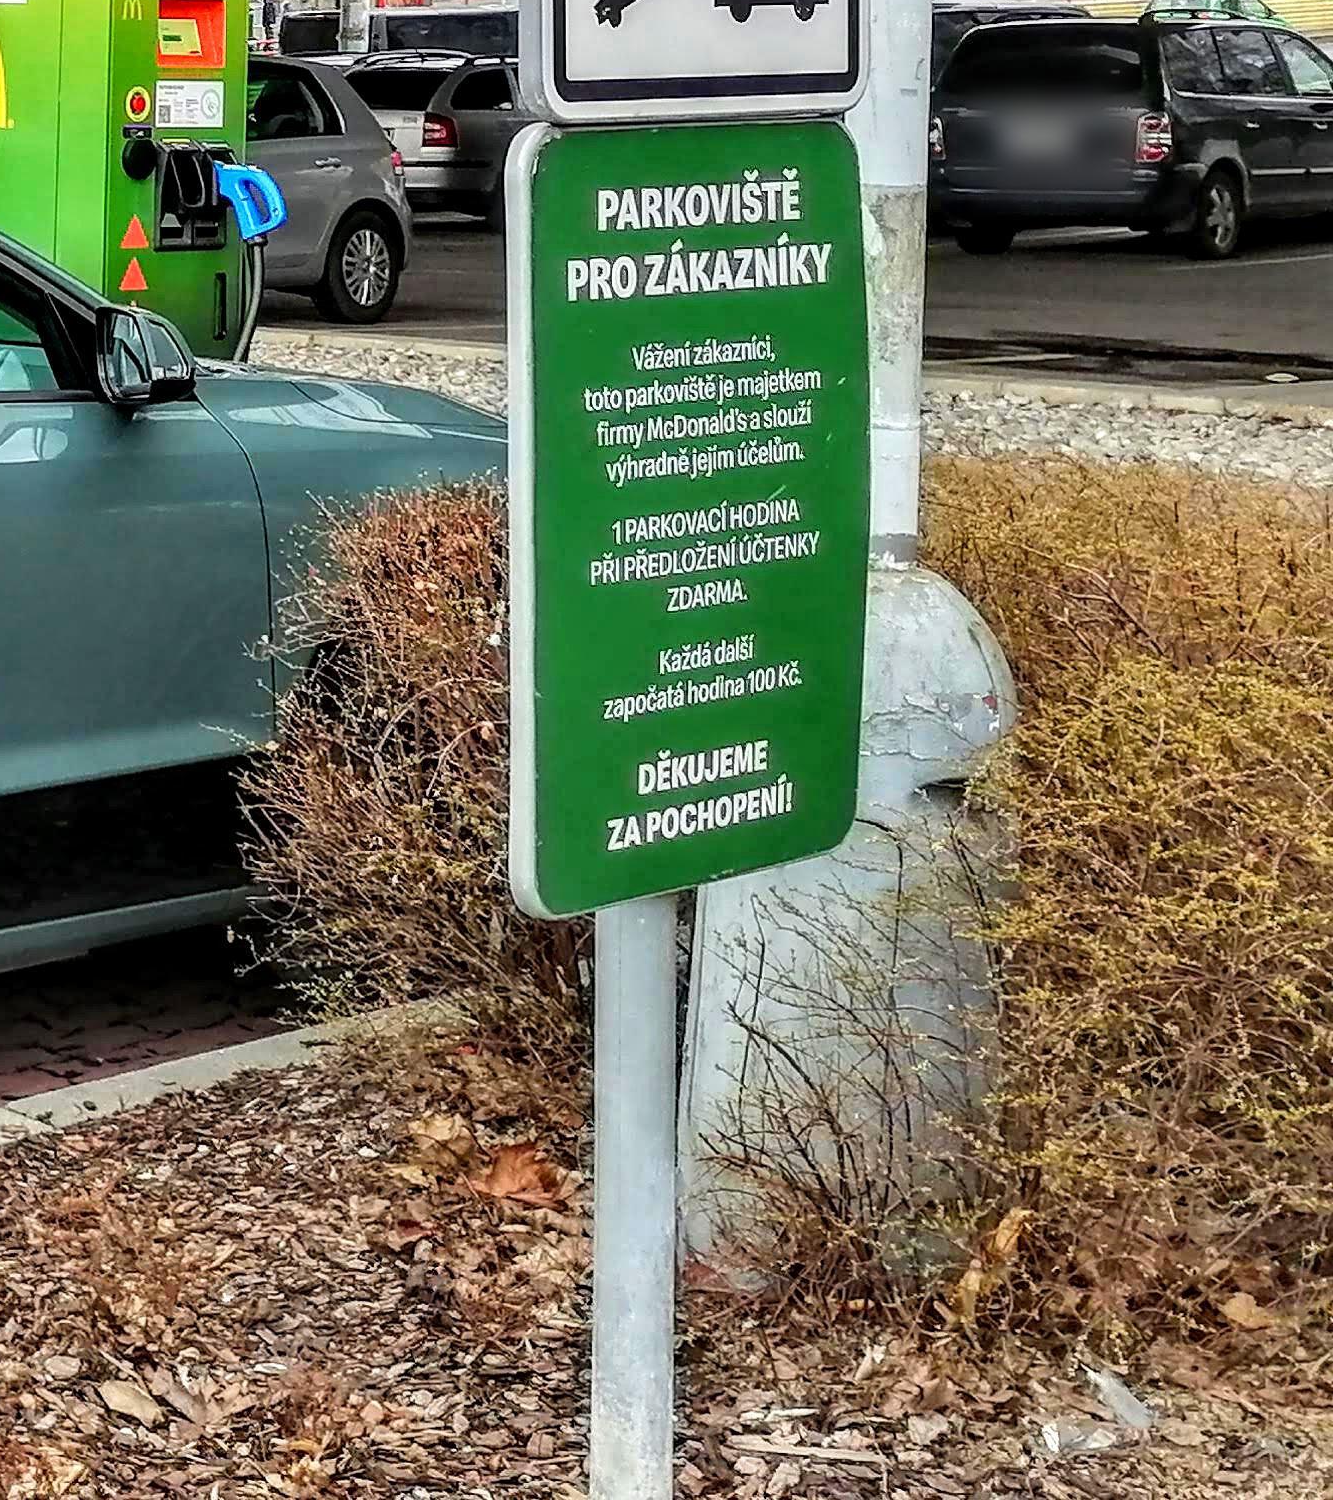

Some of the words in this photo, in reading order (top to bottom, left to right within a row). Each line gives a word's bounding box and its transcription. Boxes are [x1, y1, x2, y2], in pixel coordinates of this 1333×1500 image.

[597, 167, 802, 231] PARKOVIŠTĚ
[567, 256, 637, 301] PRO
[644, 232, 832, 296] ZÁKAZNÍKY
[632, 338, 691, 371] Vážení
[693, 334, 776, 367] zákazníci,
[584, 385, 623, 412] toto
[625, 373, 716, 413] parkoviště
[717, 376, 735, 403] je
[738, 368, 821, 398] majetkem
[596, 419, 646, 448] firmy
[750, 412, 761, 428] a
[763, 399, 813, 426] slouží
[605, 447, 690, 488] výhradně
[690, 444, 735, 479] jejím
[737, 435, 806, 467] účelům.
[611, 521, 622, 545] 1
[625, 501, 727, 542] PARKOVACÍ
[730, 499, 800, 530] HODINA
[590, 553, 621, 586] PŘI
[624, 537, 736, 581] PŘEDLOŽENÍ
[739, 531, 821, 565] ÚČTENKY
[666, 578, 748, 612] ZDARMA.
[659, 641, 711, 675] Každá
[714, 633, 755, 665] další
[604, 680, 685, 722] započatá
[687, 674, 745, 704] hodina
[747, 667, 775, 694] 100
[778, 660, 803, 687] Kč.
[637, 739, 769, 796] DĚKUJEME
[606, 817, 641, 852] ZA
[646, 773, 794, 843] POCHOPENÍ!
